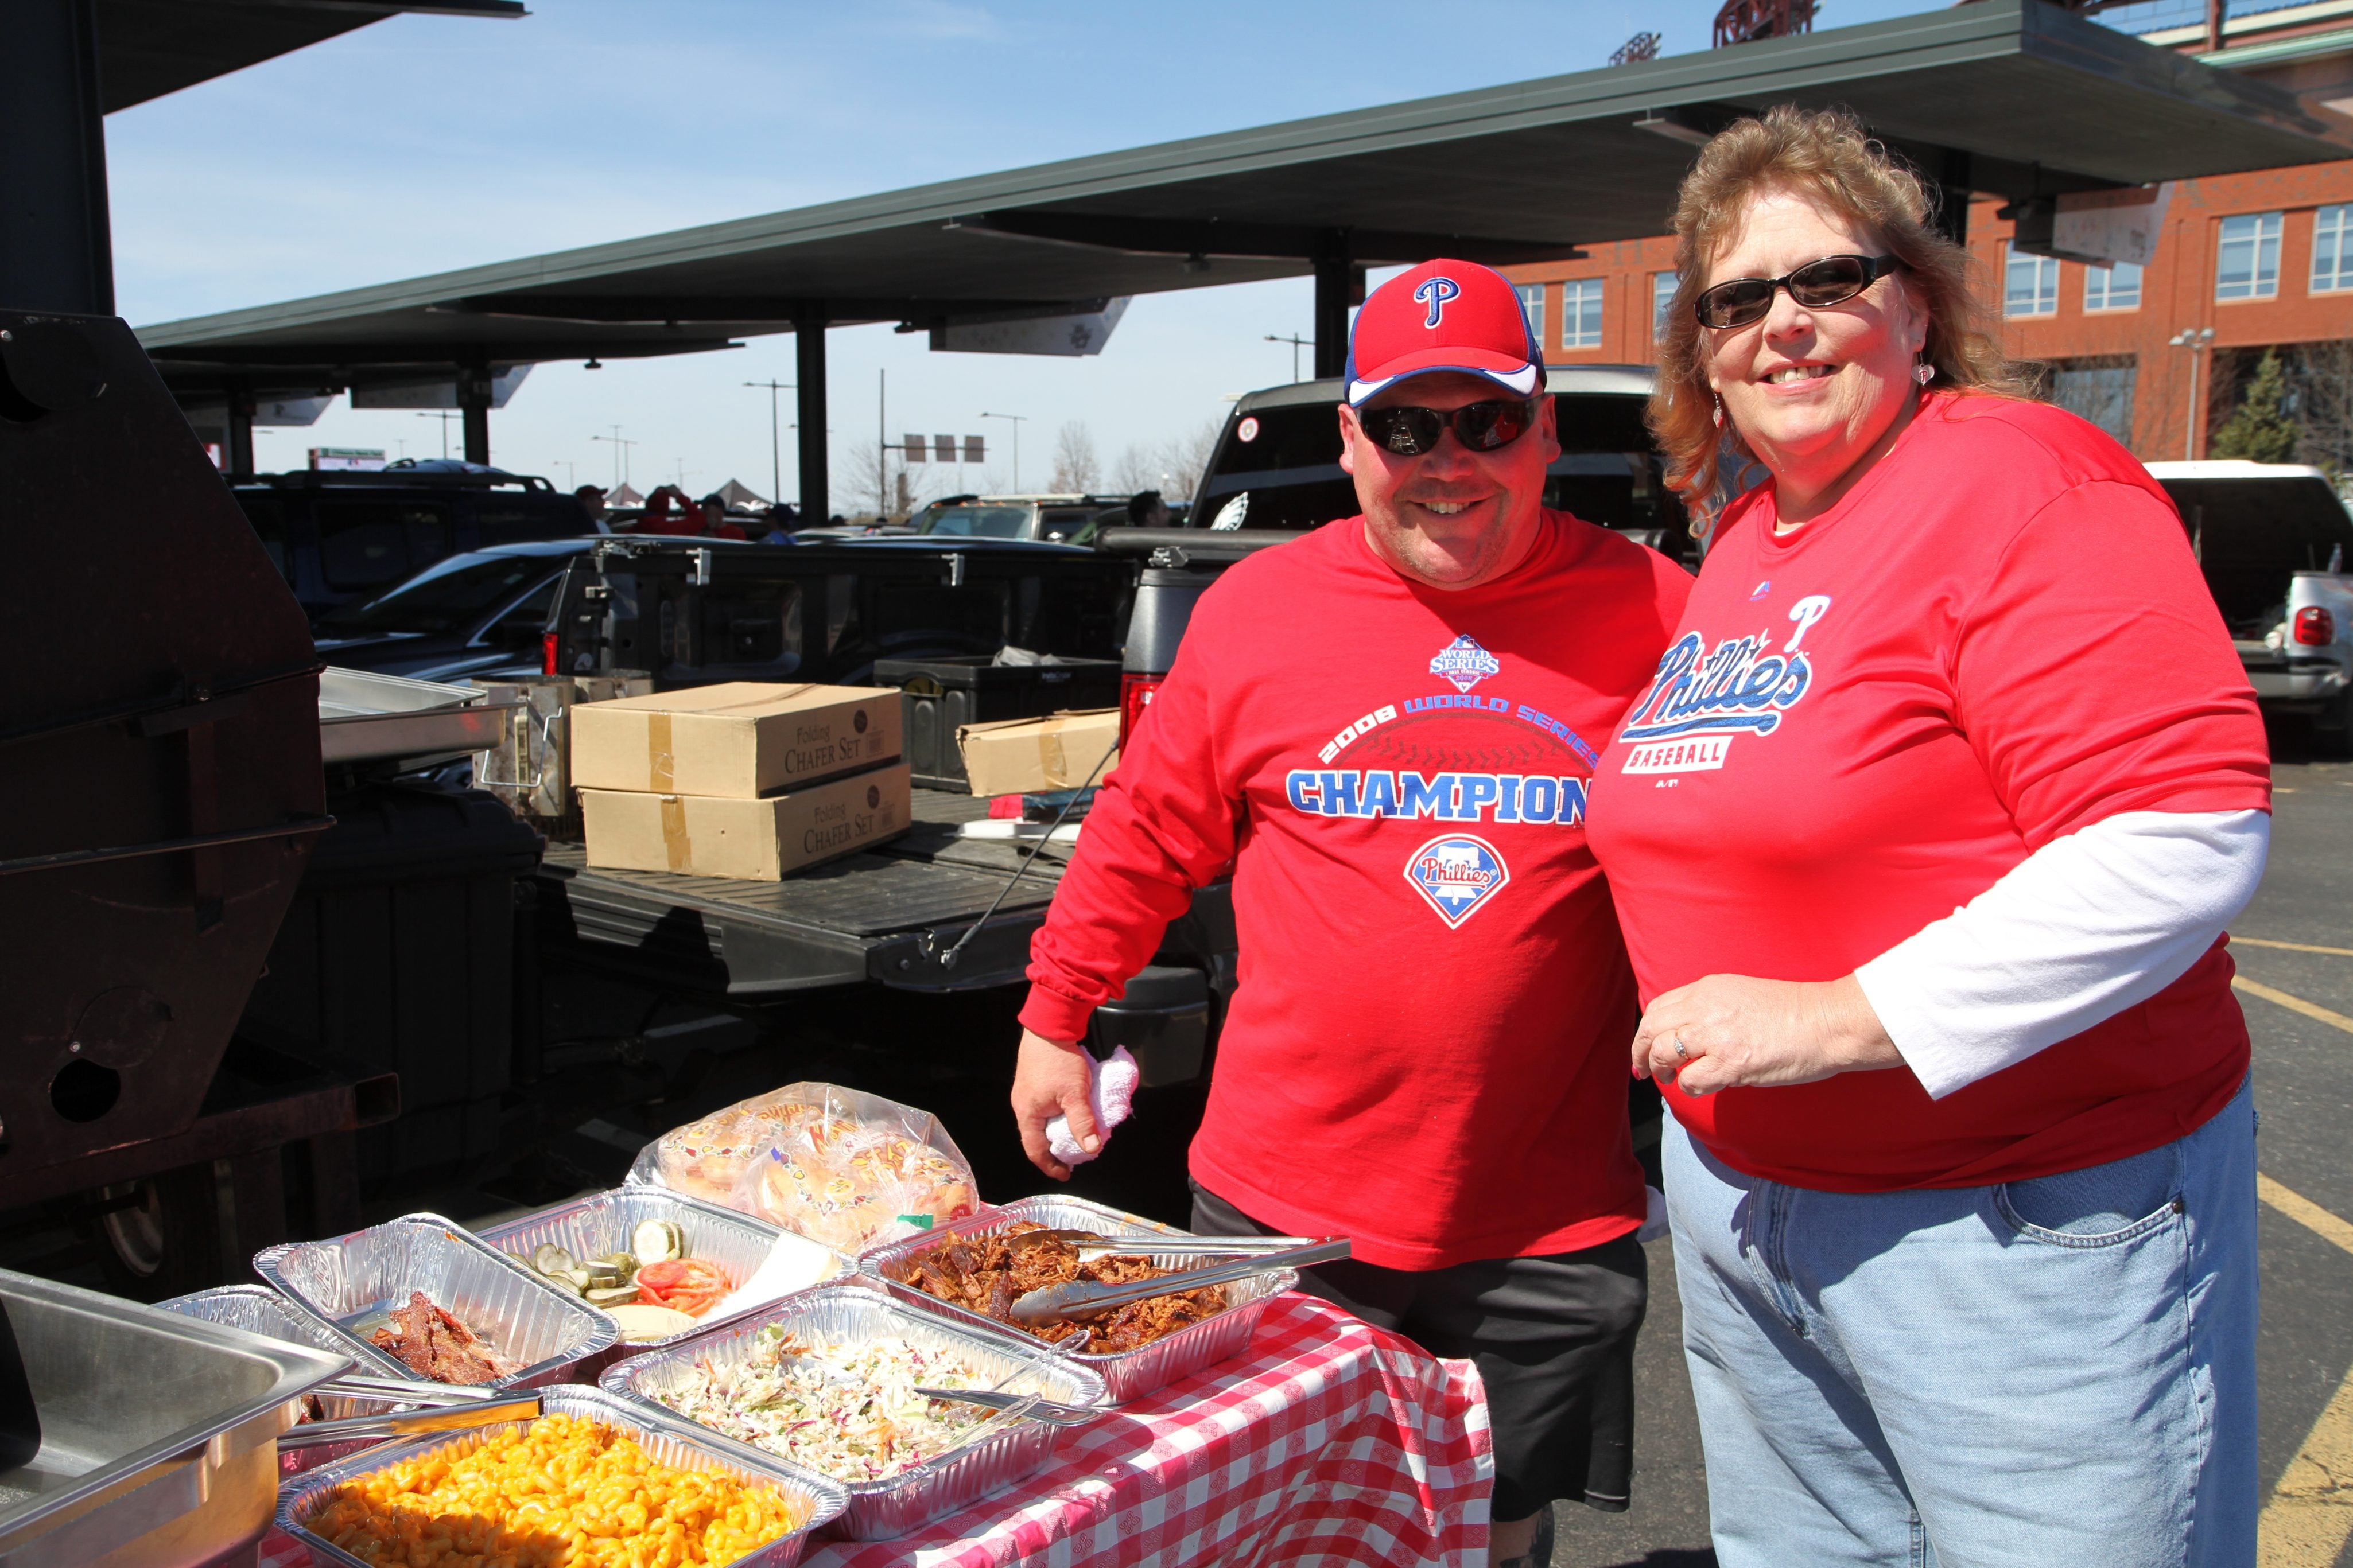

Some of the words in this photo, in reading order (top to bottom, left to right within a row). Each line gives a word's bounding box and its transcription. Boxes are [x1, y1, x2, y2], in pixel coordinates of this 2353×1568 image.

[1414, 277, 1460, 329] P
[1784, 595, 1832, 652] P
[1430, 657, 1500, 674] SERIES
[1439, 649, 1490, 659] WORLD
[1628, 629, 1812, 726] Phillies
[797, 724, 830, 745] Folding
[1318, 704, 1397, 764] 2008
[1404, 694, 1509, 713] WORLD
[1516, 703, 1600, 769] SERIES
[785, 745, 835, 774] CHAFER
[839, 737, 861, 761] SET
[1629, 742, 1720, 767] BASEBALL
[814, 803, 846, 825] Folding
[804, 822, 851, 854] CHAFER
[855, 813, 874, 838] SET
[1420, 857, 1490, 884] Phillies
